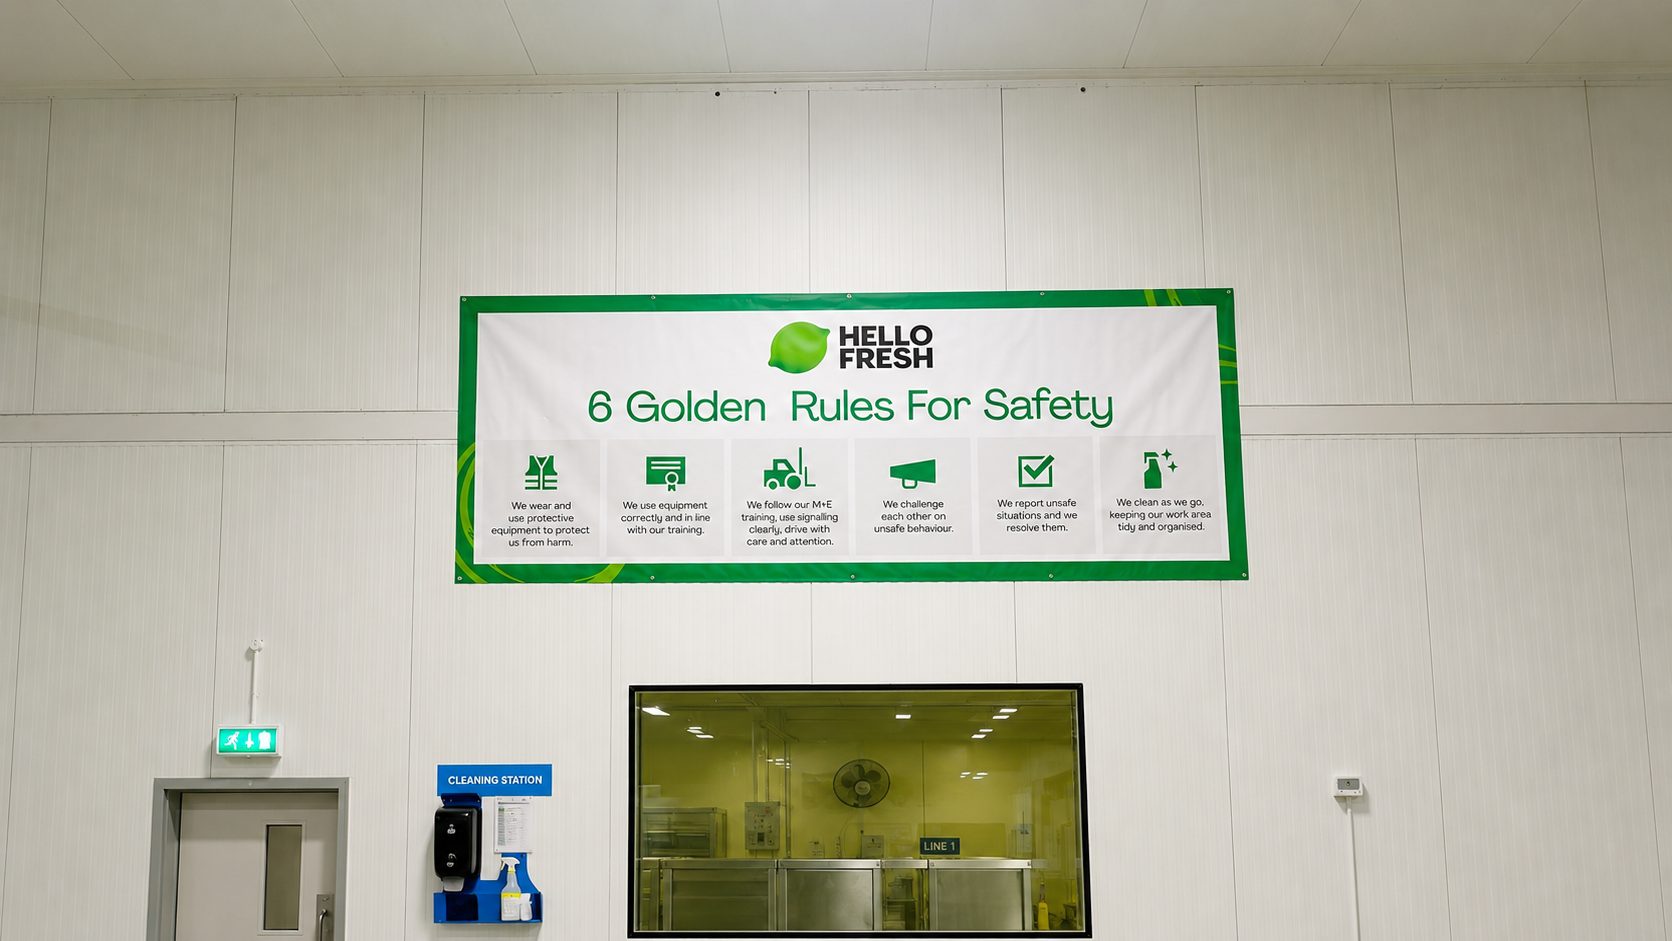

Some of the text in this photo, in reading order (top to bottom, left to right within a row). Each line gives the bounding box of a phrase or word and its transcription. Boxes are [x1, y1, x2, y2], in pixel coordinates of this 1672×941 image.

[839, 324, 933, 346] HELLO
[839, 347, 934, 369] FRESH
[588, 387, 1113, 428] 6 Golden Rules For Safety
[511, 501, 571, 511] We wear and
[622, 501, 708, 512] We use equipment
[746, 500, 832, 510] We follow our M+E
[883, 500, 944, 511] We challenge
[997, 498, 1077, 510] We report unsafe
[1116, 498, 1132, 508] We
[1134, 498, 1159, 508] clean
[1161, 498, 1172, 507] as
[1173, 498, 1188, 507] we
[508, 513, 574, 525] use protective
[620, 513, 711, 525] correctly and in line
[741, 512, 838, 524] training, use signalling
[881, 512, 946, 522] each other on
[996, 511, 1078, 521] situations and we
[1109, 510, 1212, 522] keeping our work area
[491, 526, 590, 537] equipment to protect
[627, 525, 704, 537] with our training.
[749, 524, 830, 536] clearly, drive with
[874, 523, 954, 534] unsafe behaviour.
[1006, 523, 1068, 533] resolve them.
[1118, 522, 1205, 534] tidy and organised.
[508, 537, 573, 548] us from harm.
[746, 537, 834, 547] care and attention.
[448, 775, 543, 785] CLEANING STATION
[923, 841, 955, 851] LINE 1
